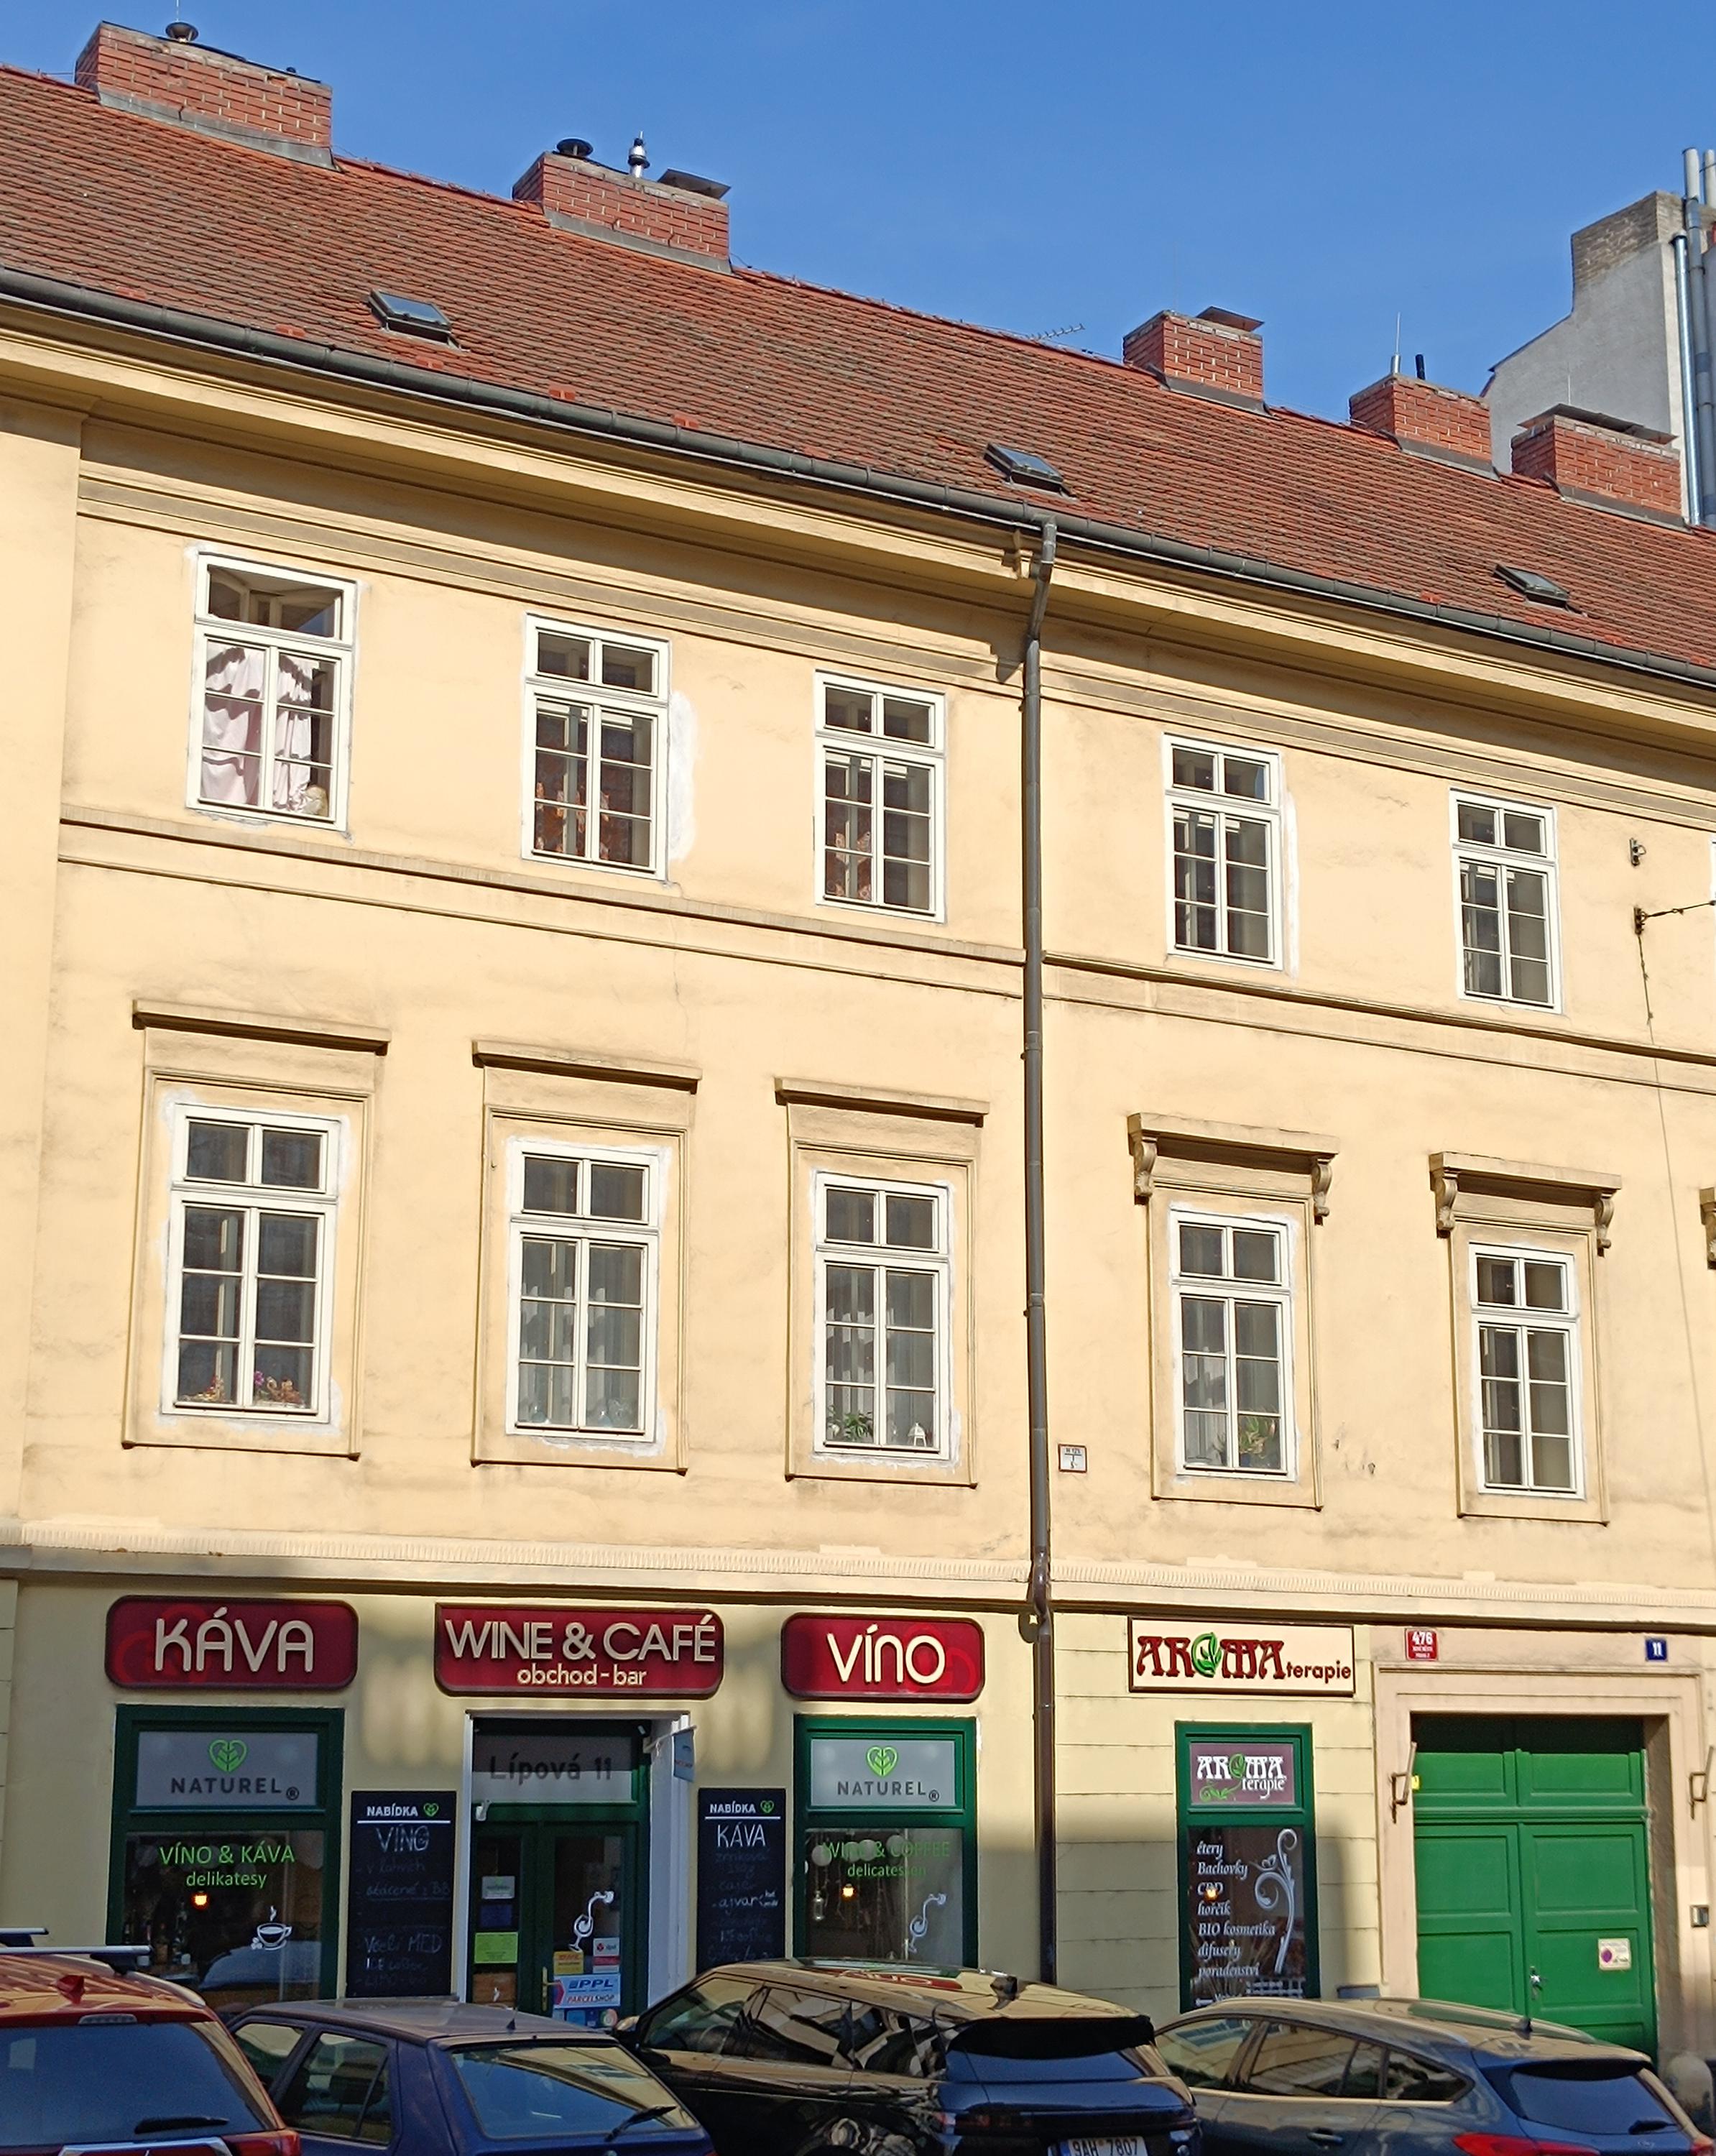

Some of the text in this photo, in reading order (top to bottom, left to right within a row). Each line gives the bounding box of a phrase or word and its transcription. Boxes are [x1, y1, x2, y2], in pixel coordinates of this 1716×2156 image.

[155, 1607, 314, 1672] KÁVA
[445, 1614, 716, 1662] WINE & CAFÉ
[1412, 1631, 1433, 1645] 476
[1652, 1641, 1664, 1657] 11
[517, 1662, 598, 1686] obchod
[612, 1664, 647, 1686] bar
[489, 1752, 612, 1786] Lípová 11
[1196, 1753, 1284, 1779] AROMA
[170, 1777, 282, 1795] NATUREL
[837, 1781, 927, 1796] NATUREL
[1242, 1775, 1287, 1800] terapie
[366, 1802, 419, 1817] NABÍDKA
[710, 1800, 756, 1814] NABÍDKA
[376, 1823, 430, 1852] VÍNO
[717, 1821, 767, 1848] KÁVA
[160, 1841, 295, 1864] VÍNO & KÁVA
[822, 1841, 868, 1858] WI
[875, 1841, 885, 1858] &
[1197, 1858, 1248, 1881] Bachovky
[186, 1871, 267, 1889] delikatesy
[1199, 1920, 1276, 1936] BIO kosmetika
[407, 1932, 443, 1953] MED
[1198, 1961, 1260, 1979] poradenství
[578, 1978, 614, 1989] PPL
